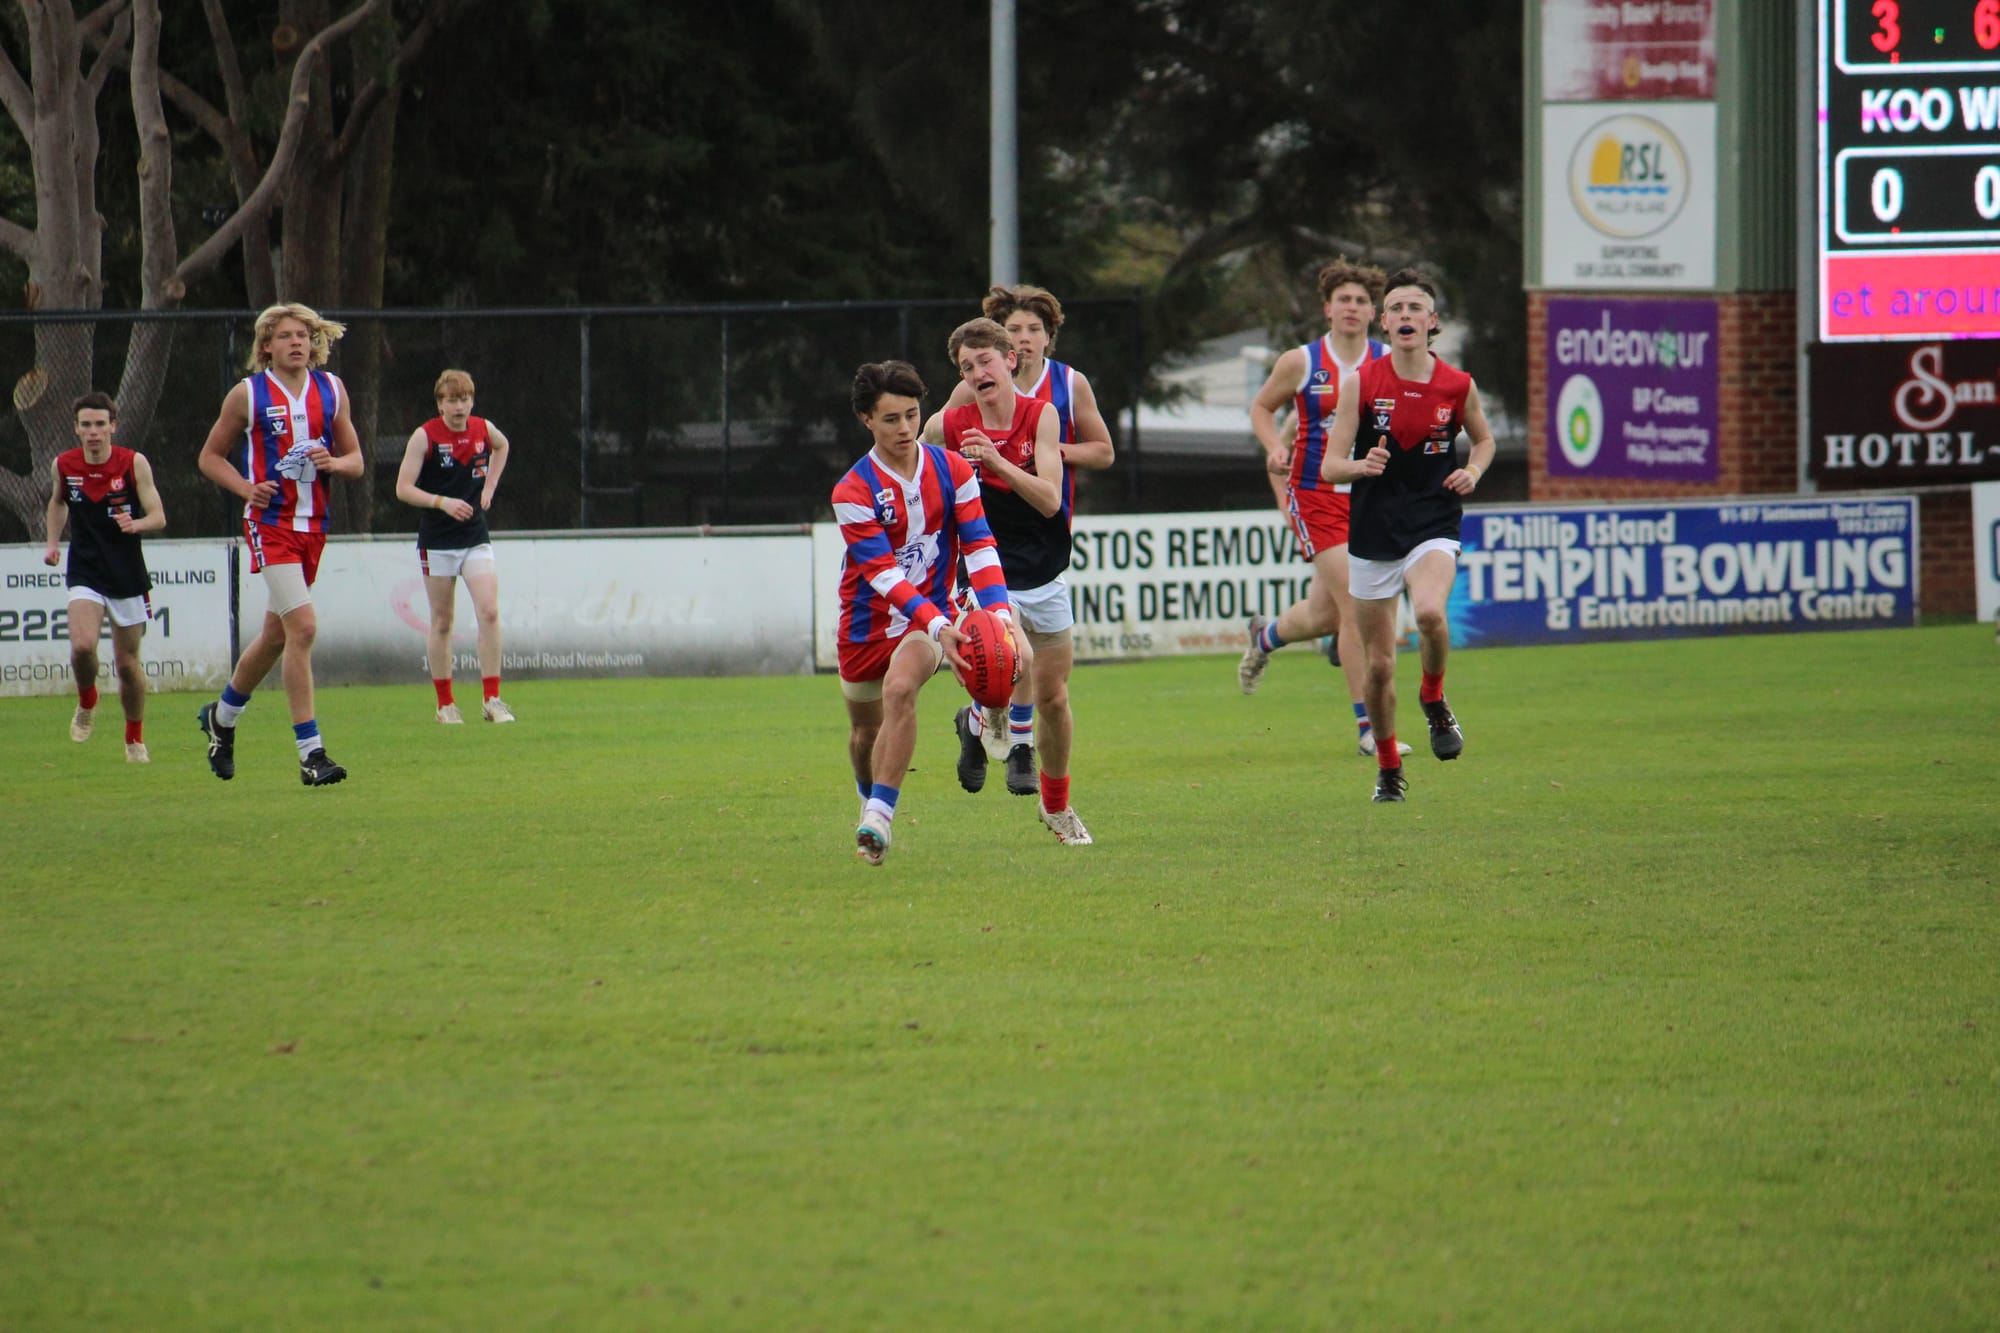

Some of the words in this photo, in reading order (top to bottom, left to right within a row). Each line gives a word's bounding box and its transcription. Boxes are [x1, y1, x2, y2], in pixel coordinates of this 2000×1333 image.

[1871, 0, 1900, 52] 3
[1861, 88, 1954, 133] KOO
[1959, 86, 2000, 131] W
[1620, 143, 1666, 181] RSL
[1871, 168, 1903, 222] 0
[1833, 283, 1872, 317] et
[1556, 309, 1710, 369] endeavour
[1895, 345, 1995, 430] San
[1824, 432, 1984, 468] HOTEL
[1483, 513, 1579, 551] Phillip
[1586, 511, 1676, 547] Island
[1460, 545, 1648, 602] TENPIN
[1661, 537, 1906, 598] BOWLING
[1579, 590, 1793, 629] Entertainment
[1800, 588, 1895, 620] Centre
[502, 653, 540, 669] Island
[542, 653, 575, 668] Road
[577, 651, 644, 667] Newhaven
[966, 623, 988, 696] SHERRIN
